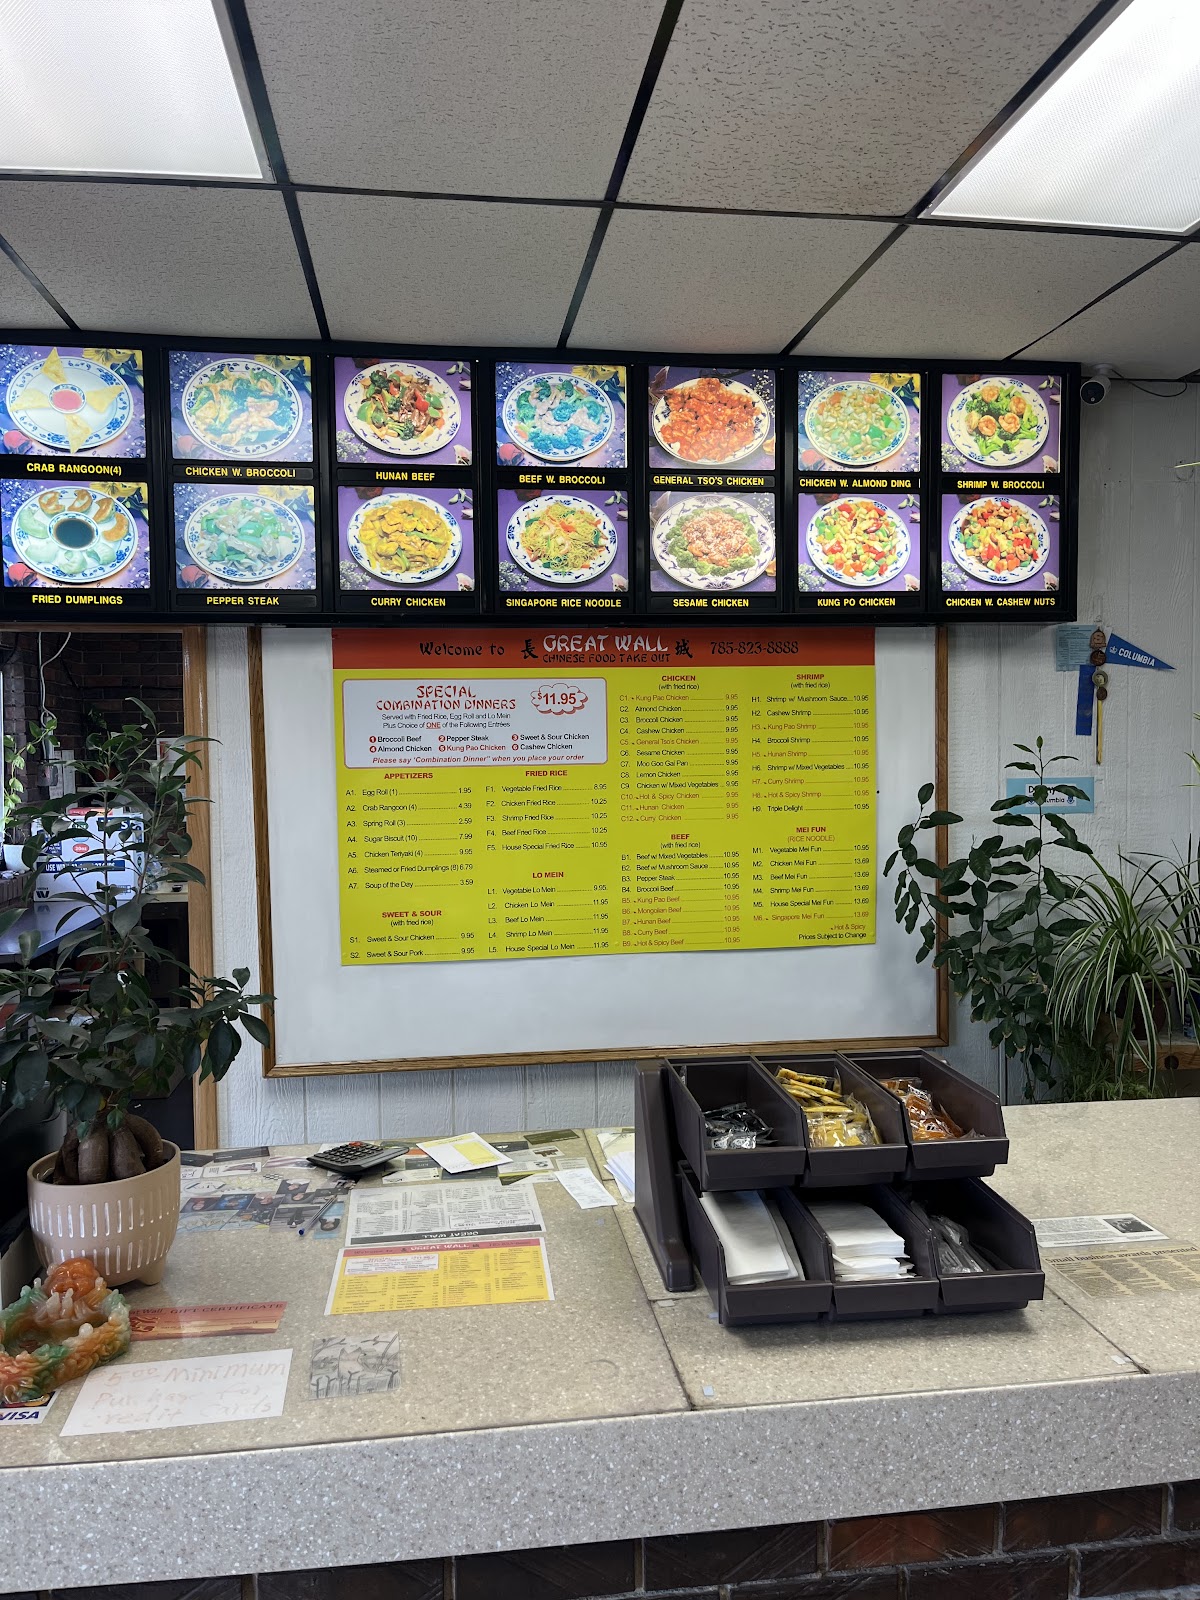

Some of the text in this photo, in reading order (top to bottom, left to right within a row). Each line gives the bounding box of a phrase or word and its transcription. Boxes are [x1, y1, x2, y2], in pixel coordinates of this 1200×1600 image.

[26, 462, 122, 477] CRAB RANGOON(4)
[185, 466, 296, 478] CHICKEN W. BROCCOLI
[375, 471, 436, 481] HUNAN BEEF
[519, 474, 606, 485] BEEF W. BROCCOLI
[653, 475, 765, 486] GENERAL TSO'S CHICKEN
[799, 478, 912, 488] CHICKEN W. ALMOND DING
[957, 480, 1045, 489] SHRIMP W. BROCCOLI
[31, 594, 123, 605] FRIED DUMPLINGS
[206, 596, 280, 606] PEPPER STEAK
[370, 597, 446, 607] CURRY CHICKEN
[505, 598, 622, 608] SINGAPORE RICE NOODLE
[672, 598, 749, 608] SESAME CHICKEN
[817, 597, 896, 607] KUNG PO CHICKEN
[945, 597, 1056, 607] CHICKEN W. CASHEW NUTS
[521, 638, 538, 659] 長
[543, 634, 669, 652] GREAT WALL
[710, 640, 798, 654] 785-823-8888
[420, 642, 504, 656] Welcome to
[542, 652, 670, 663] CHINESE FOOD TAKE OUT
[1118, 647, 1155, 667] COLUMBIA
[416, 685, 476, 698] SPECIAL
[376, 698, 516, 711] COMBINATION DINNERS
[536, 690, 578, 708] $11.95
[433, 713, 448, 721] Rice,
[449, 713, 462, 721] Egg
[512, 755, 528, 763] you
[529, 754, 547, 762] place
[548, 754, 564, 762] your
[362, 789, 375, 797] Egg
[376, 788, 388, 796] Roll
[389, 788, 398, 796] (1)
[783, 804, 804, 812] Delight
[45, 864, 54, 872] USE
[1074, 1254, 1116, 1262] business
[1151, 1246, 1198, 1256] presented
[170, 1306, 200, 1314] GIFT
[202, 1303, 284, 1313] CERTIFICATE
[163, 1362, 286, 1383] Minimum
